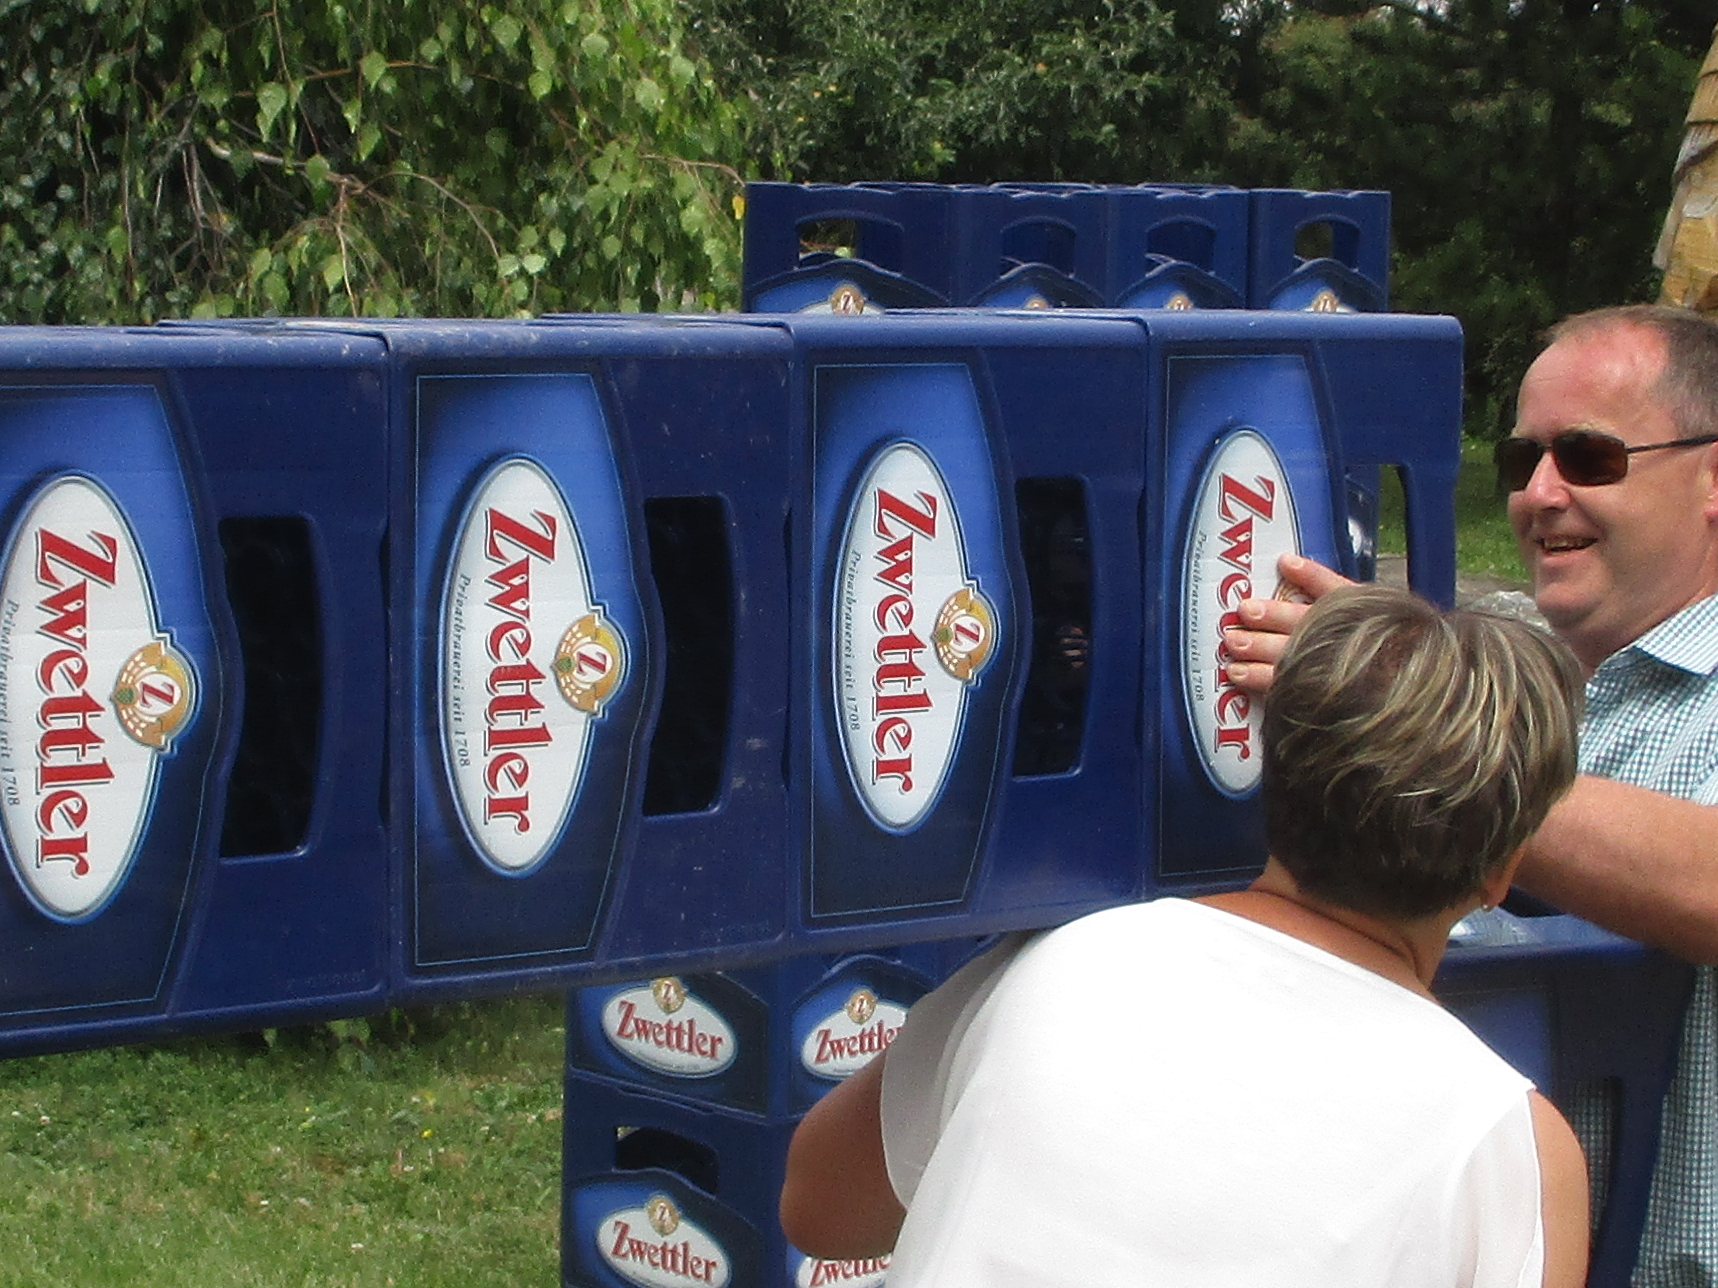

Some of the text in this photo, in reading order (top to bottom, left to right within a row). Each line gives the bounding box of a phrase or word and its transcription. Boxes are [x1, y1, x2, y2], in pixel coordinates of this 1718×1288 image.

[483, 506, 559, 835] Zwettler
[870, 486, 940, 795] Zwettler
[35, 526, 118, 880] Zwettler
[845, 696, 861, 731] 1708
[454, 731, 471, 767] 1708
[2, 767, 21, 807] 1708
[616, 1000, 724, 1060] Zwettler
[611, 1220, 718, 1283] Zwettler
